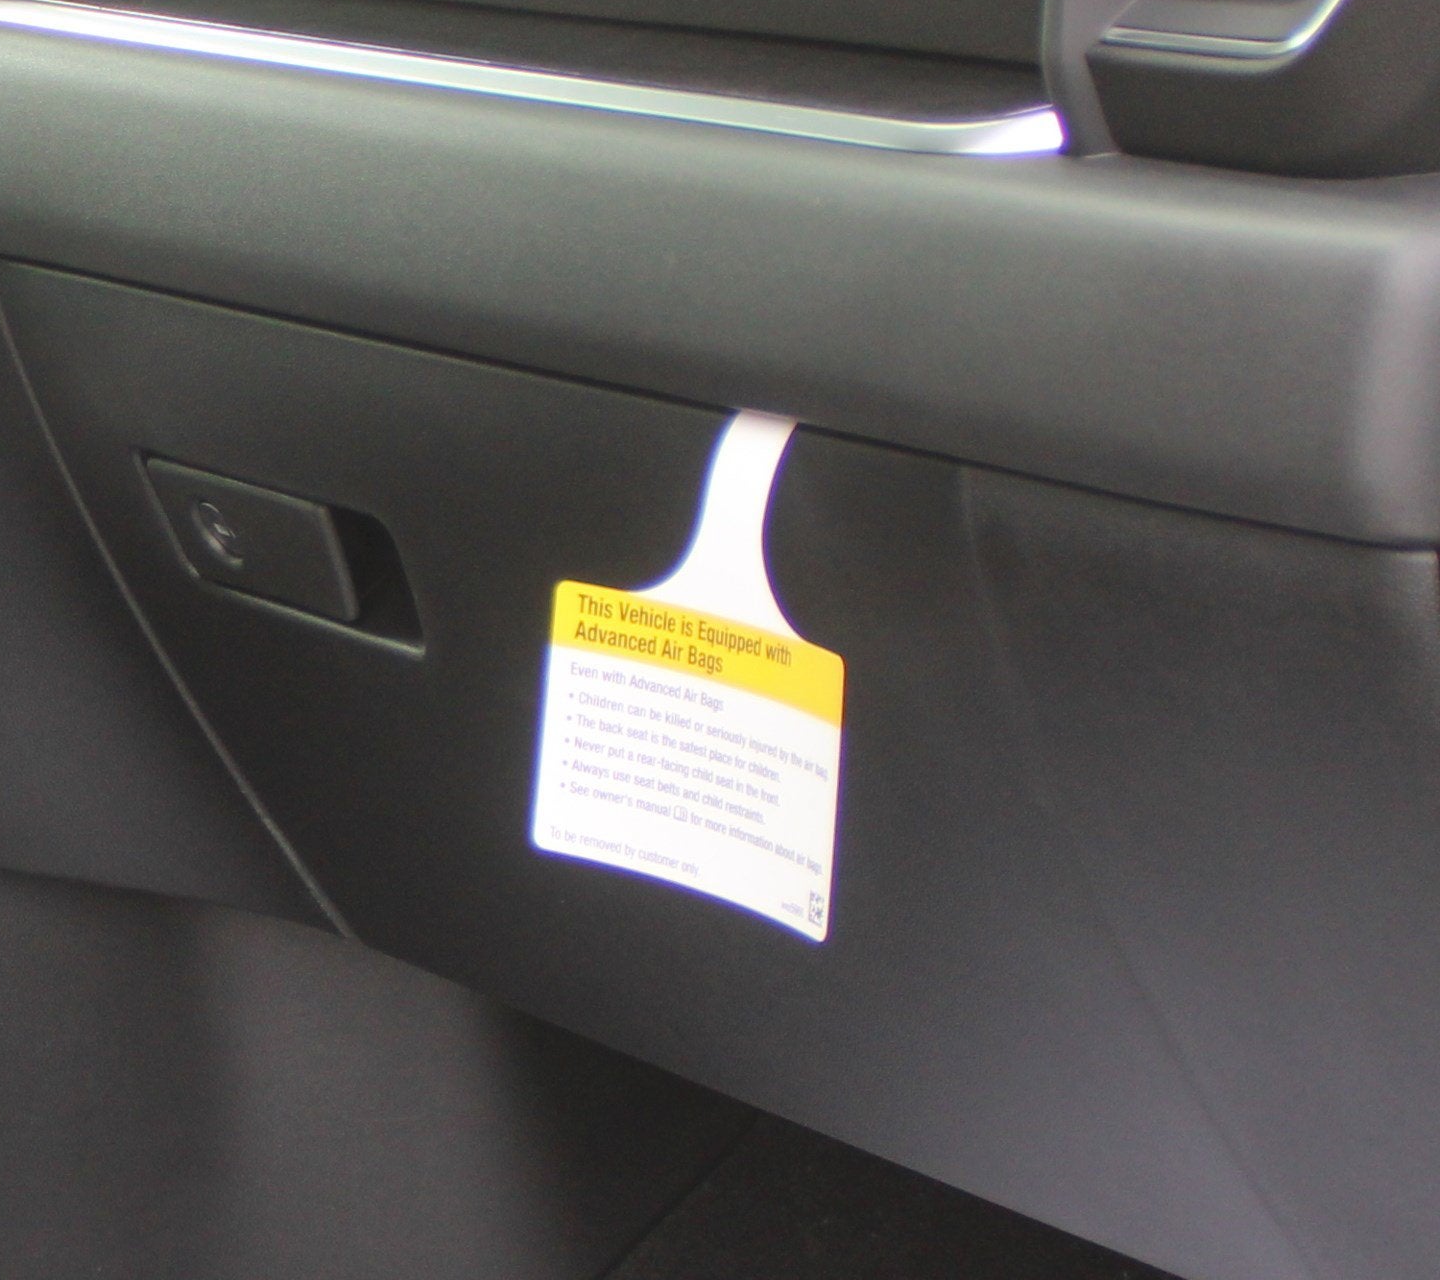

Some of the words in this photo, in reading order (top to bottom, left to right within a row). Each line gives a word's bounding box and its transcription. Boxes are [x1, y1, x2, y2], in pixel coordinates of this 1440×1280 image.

[574, 621, 658, 656] Advanced
[661, 638, 683, 662] Air
[687, 645, 723, 674] Bags
[577, 593, 613, 618] This
[620, 601, 676, 633] Vehicle
[681, 616, 693, 637] is
[698, 620, 762, 657] Equipped
[765, 643, 792, 667] with
[570, 661, 599, 679] Even
[602, 670, 626, 685] with
[629, 674, 682, 699] Advanced
[683, 688, 697, 703] Air
[700, 692, 724, 713] Bags
[577, 713, 596, 730] The
[599, 719, 623, 736] back
[626, 726, 648, 741] seat
[651, 730, 659, 744] is
[661, 734, 677, 748] the
[679, 739, 707, 758] safest
[708, 748, 733, 765] place
[734, 755, 746, 769] for
[578, 691, 624, 712] Children
[627, 704, 646, 717] can
[649, 708, 662, 721] be
[665, 711, 691, 730] killed
[694, 721, 704, 732] or
[706, 725, 747, 749] seriously
[749, 736, 778, 757] injured
[779, 747, 789, 764] by
[790, 751, 803, 768] the
[571, 759, 610, 779] Always
[612, 769, 631, 783] use
[634, 774, 654, 791] seat
[657, 777, 681, 796] belts
[682, 787, 700, 803] and
[701, 793, 723, 810] child
[574, 736, 606, 754] Never
[607, 745, 625, 760] put
[627, 750, 634, 761] a
[636, 751, 689, 778] rear-facing
[691, 765, 713, 783] child
[715, 774, 734, 790] seat
[736, 779, 744, 794] in
[746, 782, 759, 799] the
[569, 781, 590, 797] See
[592, 789, 633, 807] owner's
[636, 797, 671, 817] manual
[690, 811, 703, 826] for
[705, 818, 727, 835] more
[728, 824, 774, 852] information
[549, 824, 561, 841] To
[564, 829, 577, 844] be
[579, 833, 622, 855] removed
[624, 843, 636, 860] by
[638, 849, 680, 869] customer
